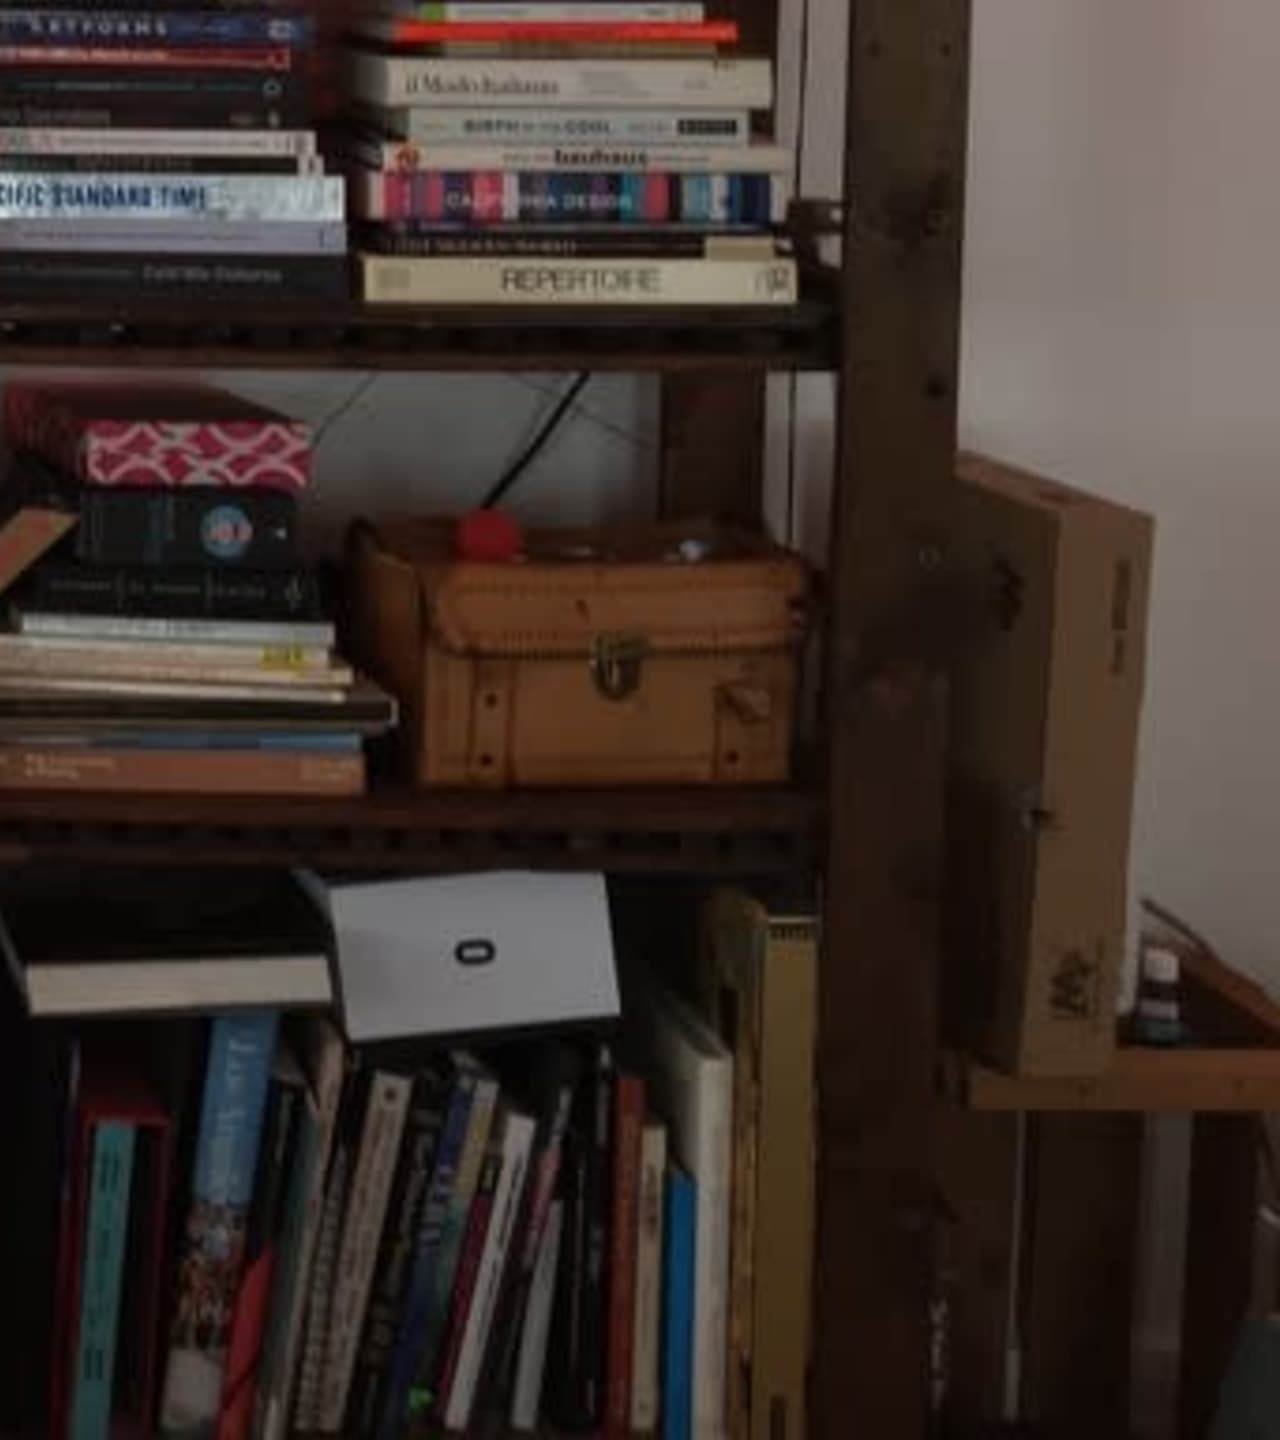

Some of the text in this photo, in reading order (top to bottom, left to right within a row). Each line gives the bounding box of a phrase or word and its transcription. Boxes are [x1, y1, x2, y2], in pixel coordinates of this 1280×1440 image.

[553, 149, 650, 166] bauhaus
[51, 181, 152, 210] STANDARD
[157, 181, 207, 210] TIME
[447, 192, 635, 210] CALIFNIA DESIGN
[501, 268, 662, 292] REPERTOIRE
